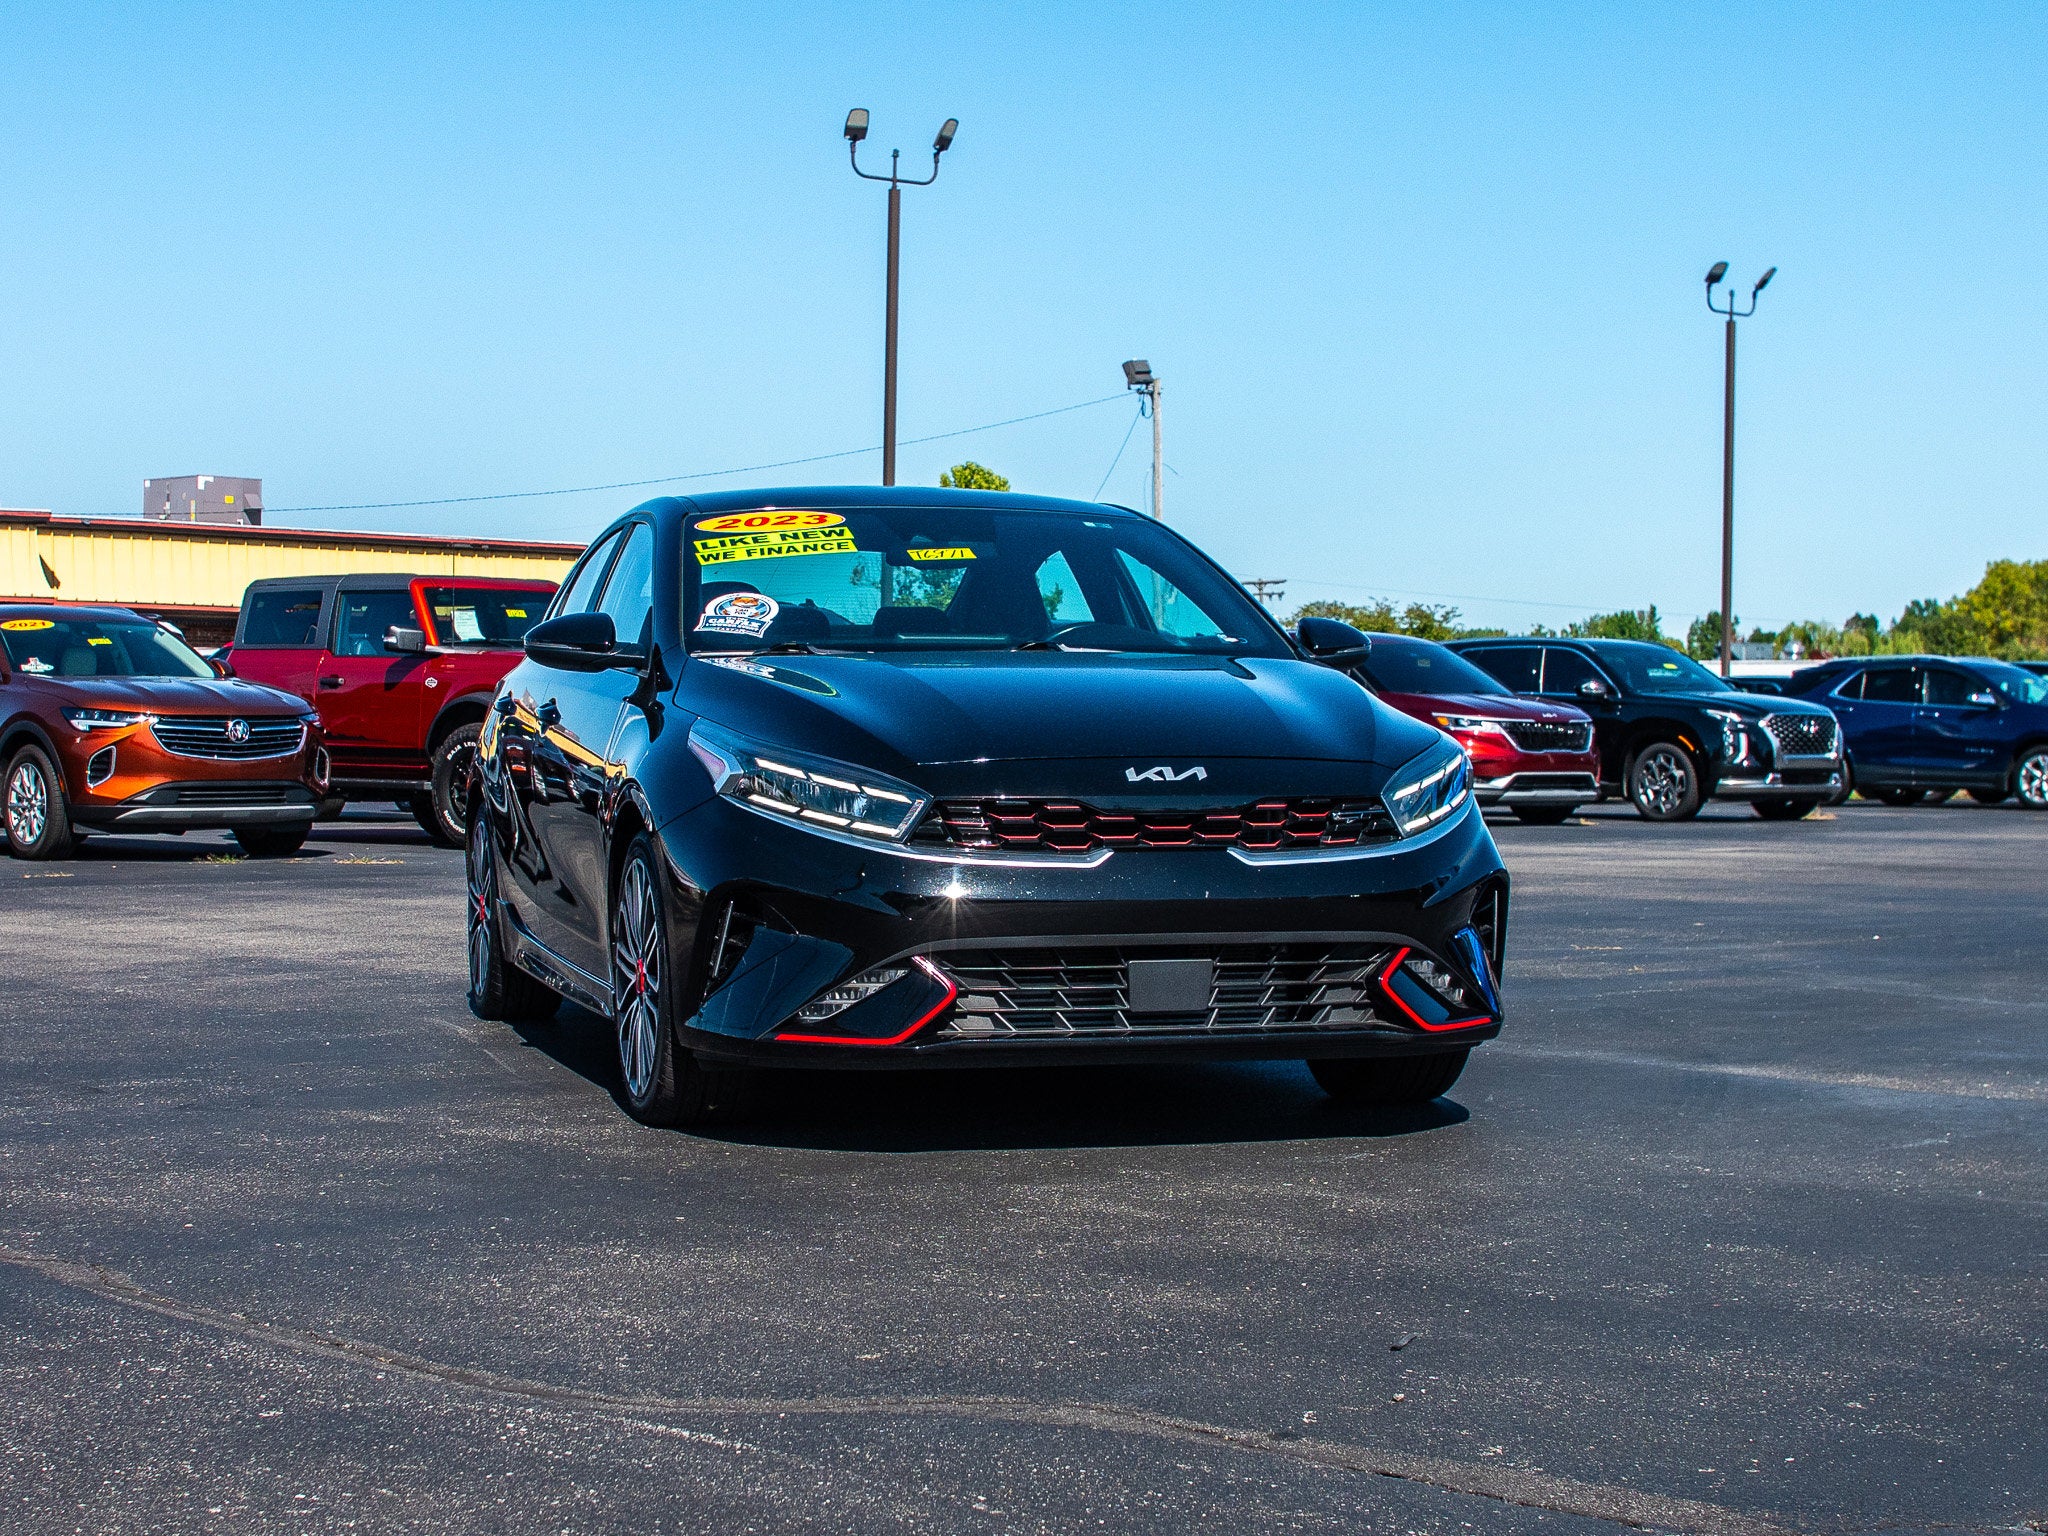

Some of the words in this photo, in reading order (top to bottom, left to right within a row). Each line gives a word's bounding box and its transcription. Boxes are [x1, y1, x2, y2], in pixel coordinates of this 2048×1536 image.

[713, 514, 828, 530] 2023
[700, 535, 770, 550] LIKE
[780, 528, 846, 542] NEW
[700, 550, 736, 562] WE
[745, 541, 851, 558] FINANCE
[1125, 766, 1208, 781] KIA
